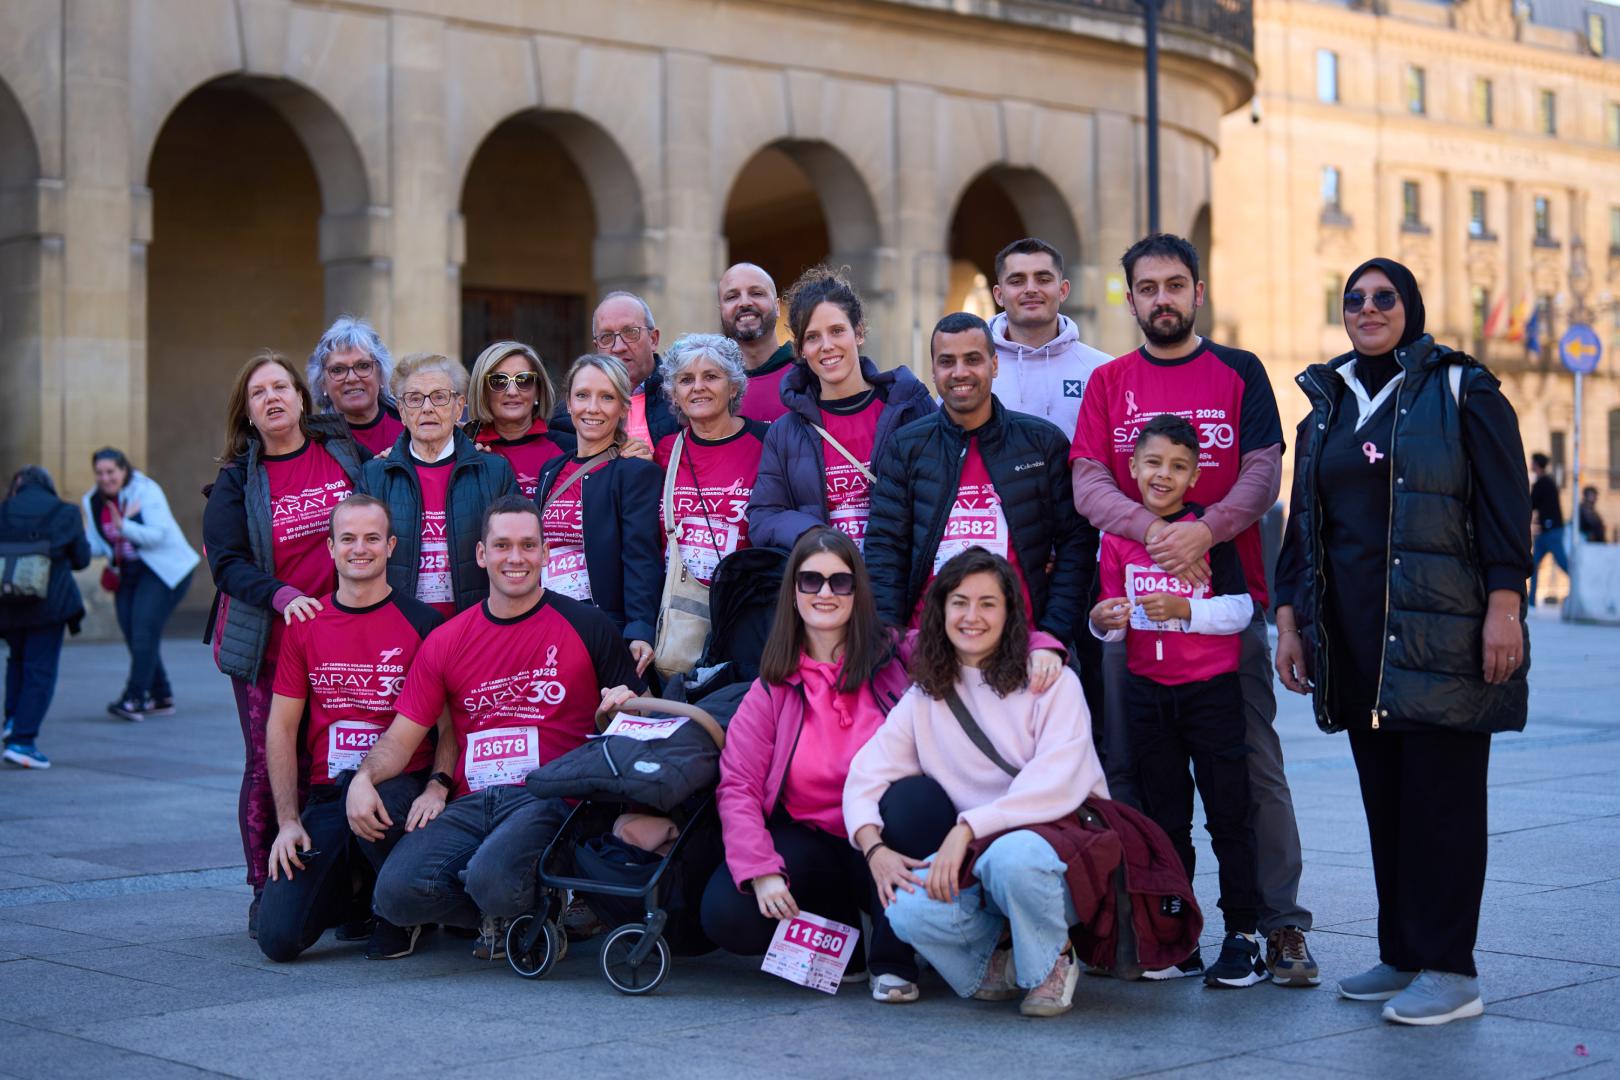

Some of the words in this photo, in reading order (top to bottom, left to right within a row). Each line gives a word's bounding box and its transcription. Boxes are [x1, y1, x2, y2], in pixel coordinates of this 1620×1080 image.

[1196, 409, 1226, 419] 2026
[1199, 423, 1234, 449] 30
[1020, 460, 1045, 471] Columbia
[272, 494, 328, 519] ARAY
[541, 508, 572, 521] RAY
[659, 497, 723, 513] RAY
[725, 499, 749, 524] 3
[684, 527, 726, 547] 2590
[832, 520, 869, 535] 257
[549, 553, 586, 574] 1427
[376, 664, 404, 673] 2026
[308, 673, 373, 688] SARAY
[377, 676, 407, 697] 30
[527, 680, 566, 705] 30
[337, 731, 379, 747] 1428
[475, 738, 526, 758] 13678
[790, 923, 843, 953] 11580
